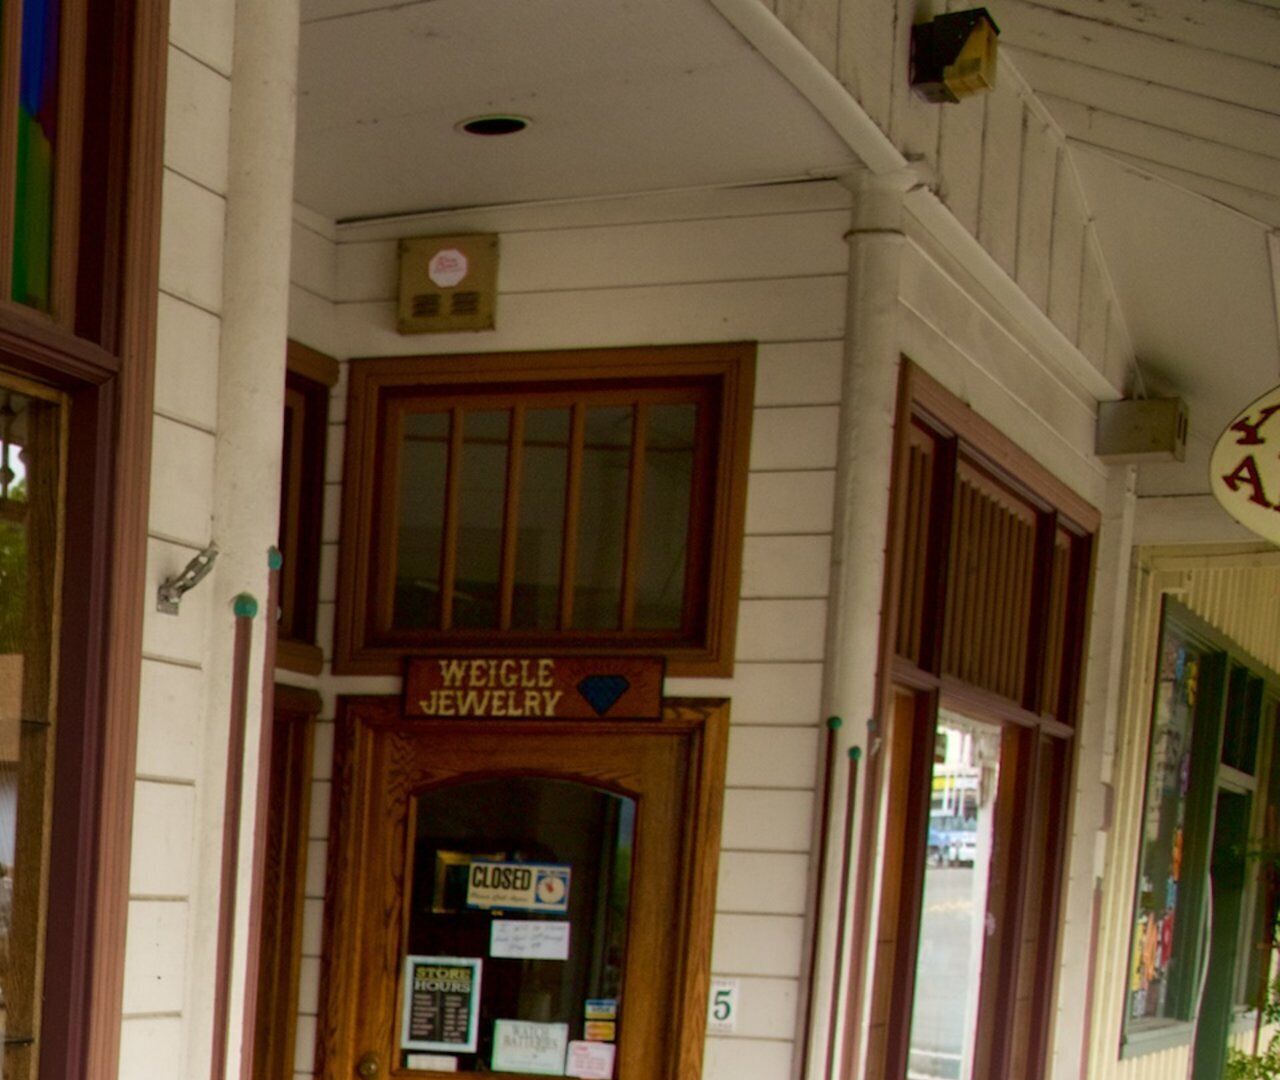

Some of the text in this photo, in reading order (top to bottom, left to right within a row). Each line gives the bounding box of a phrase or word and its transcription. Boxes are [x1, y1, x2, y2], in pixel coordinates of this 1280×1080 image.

[439, 659, 555, 688] WEIGLE
[419, 690, 563, 717] JEWELRY
[471, 866, 532, 891] CLOSED
[414, 980, 471, 993] HOURS
[415, 967, 471, 980] STORE
[713, 990, 731, 1021] 5
